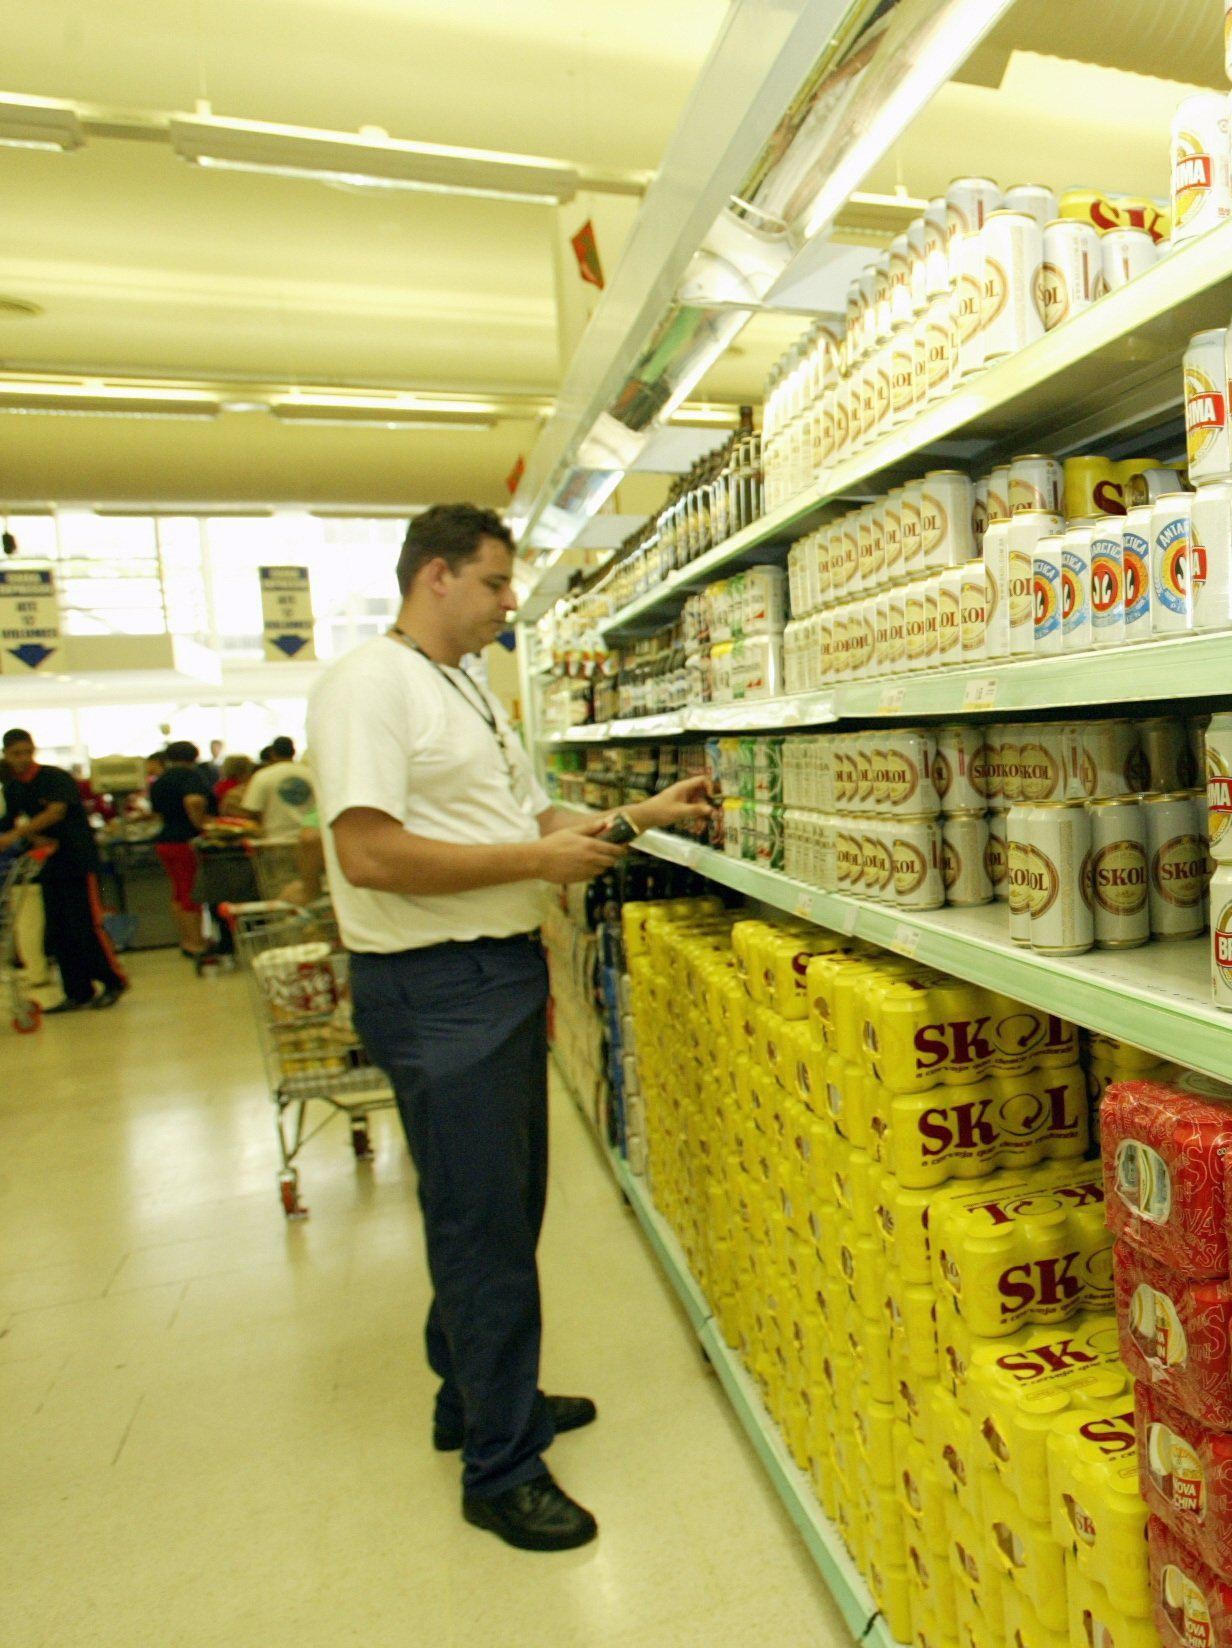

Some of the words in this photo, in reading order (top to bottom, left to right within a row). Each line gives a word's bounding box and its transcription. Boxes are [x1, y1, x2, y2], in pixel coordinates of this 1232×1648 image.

[1099, 866, 1147, 887] SKOL
[914, 1015, 1074, 1070] SKOL
[918, 1085, 1078, 1157] SKOL
